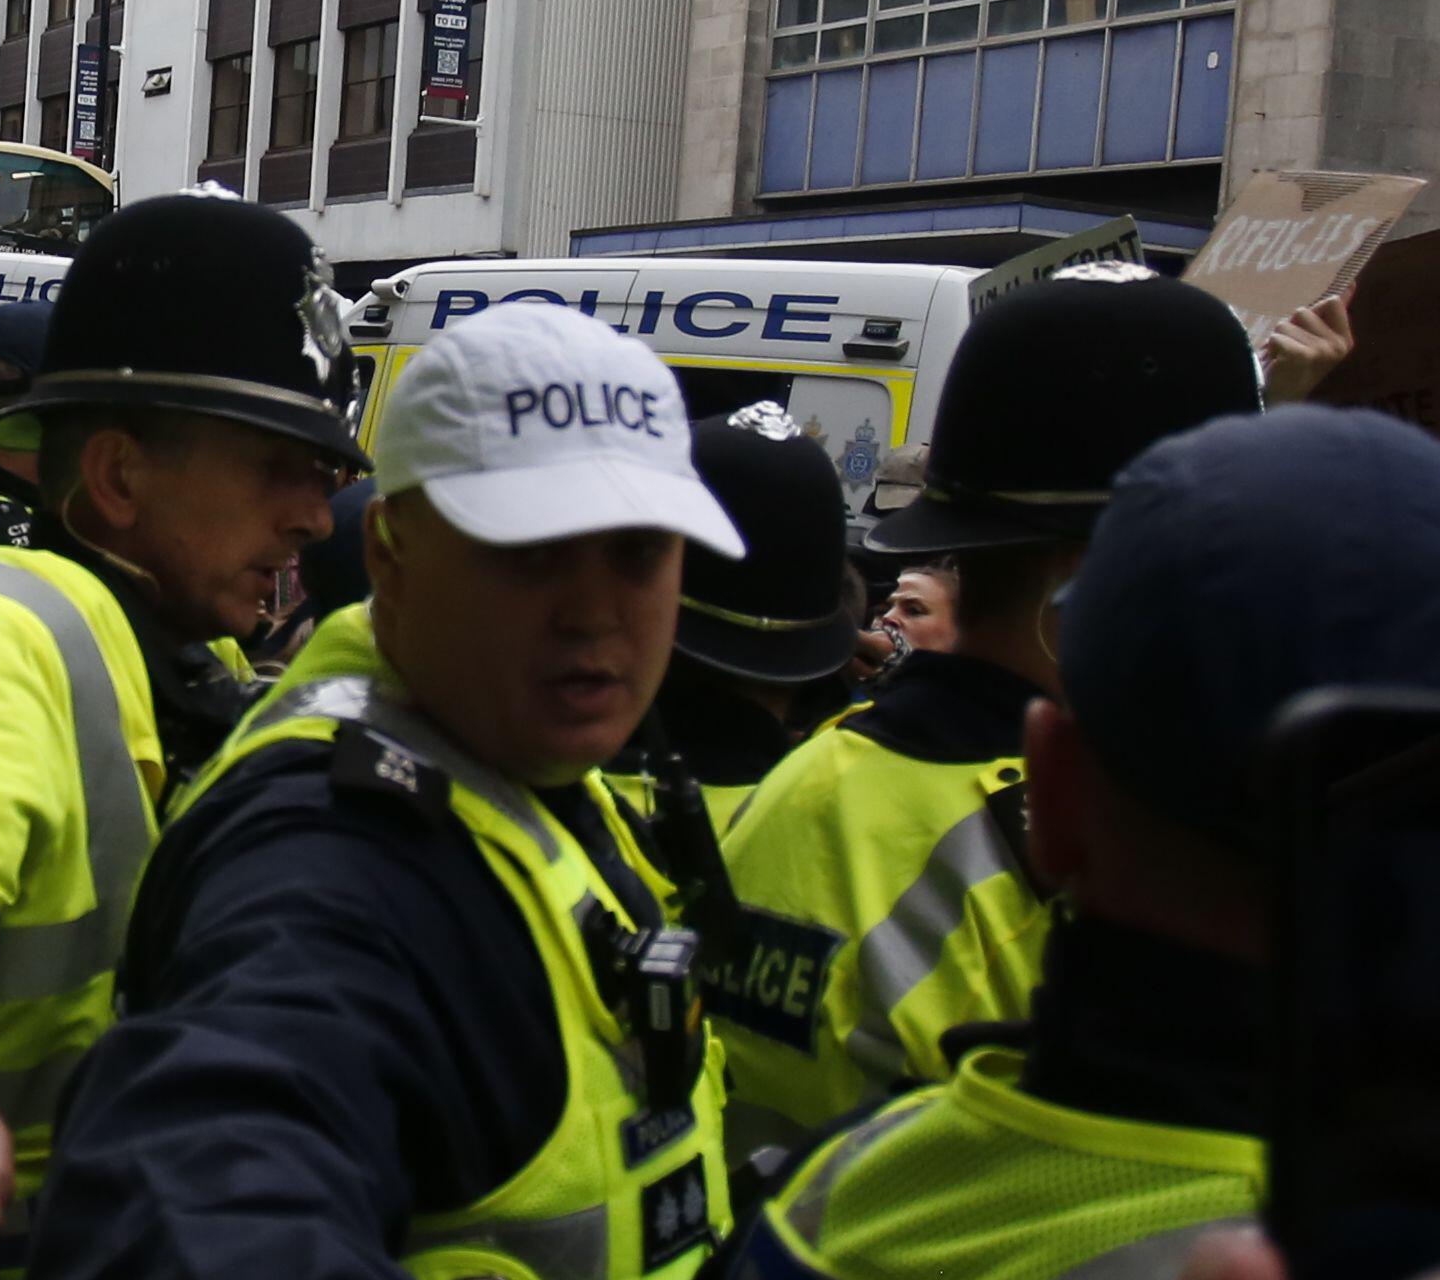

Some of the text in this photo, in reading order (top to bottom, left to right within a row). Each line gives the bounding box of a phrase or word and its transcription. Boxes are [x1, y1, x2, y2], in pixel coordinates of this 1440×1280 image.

[437, 17, 465, 27] TO LET
[430, 289, 841, 343] PLICE
[506, 382, 664, 438] POLICE
